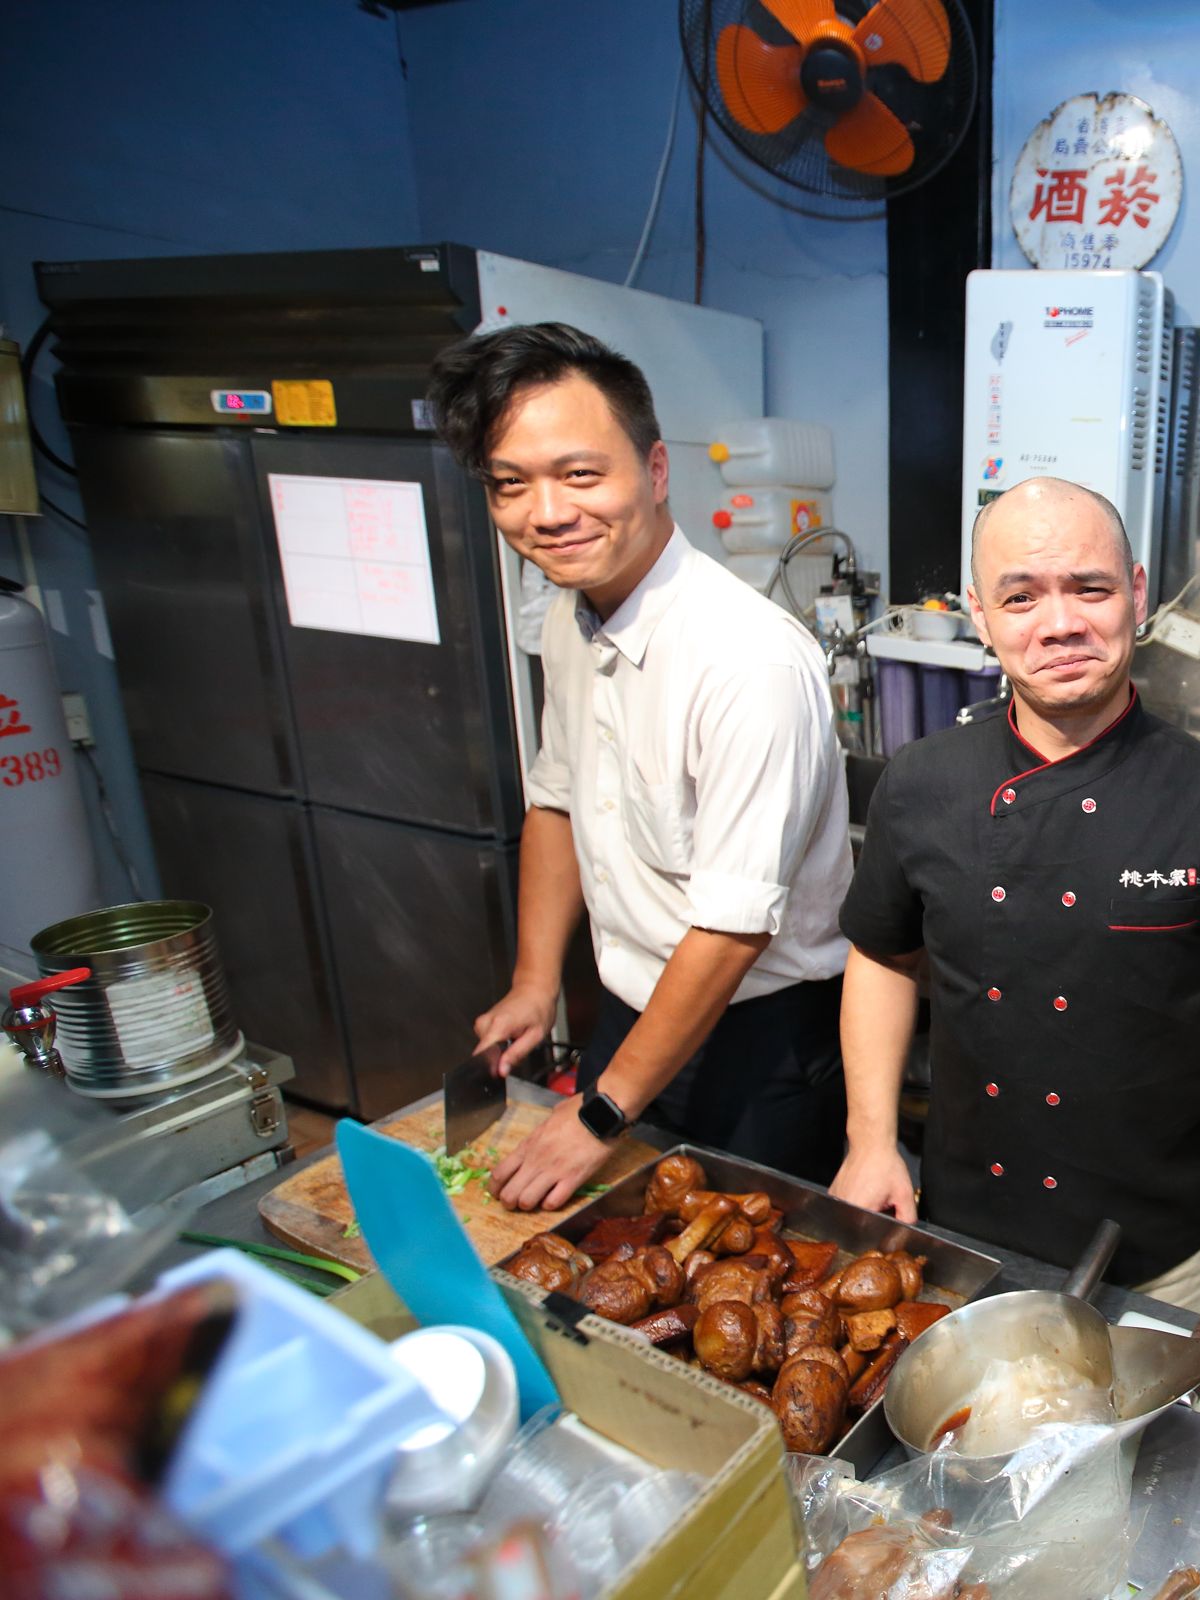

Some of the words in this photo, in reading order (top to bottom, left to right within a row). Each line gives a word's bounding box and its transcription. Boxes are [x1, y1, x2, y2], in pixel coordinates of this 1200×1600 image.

[1064, 252, 1112, 269] 15974
[1119, 869, 1187, 889] 桃本家
